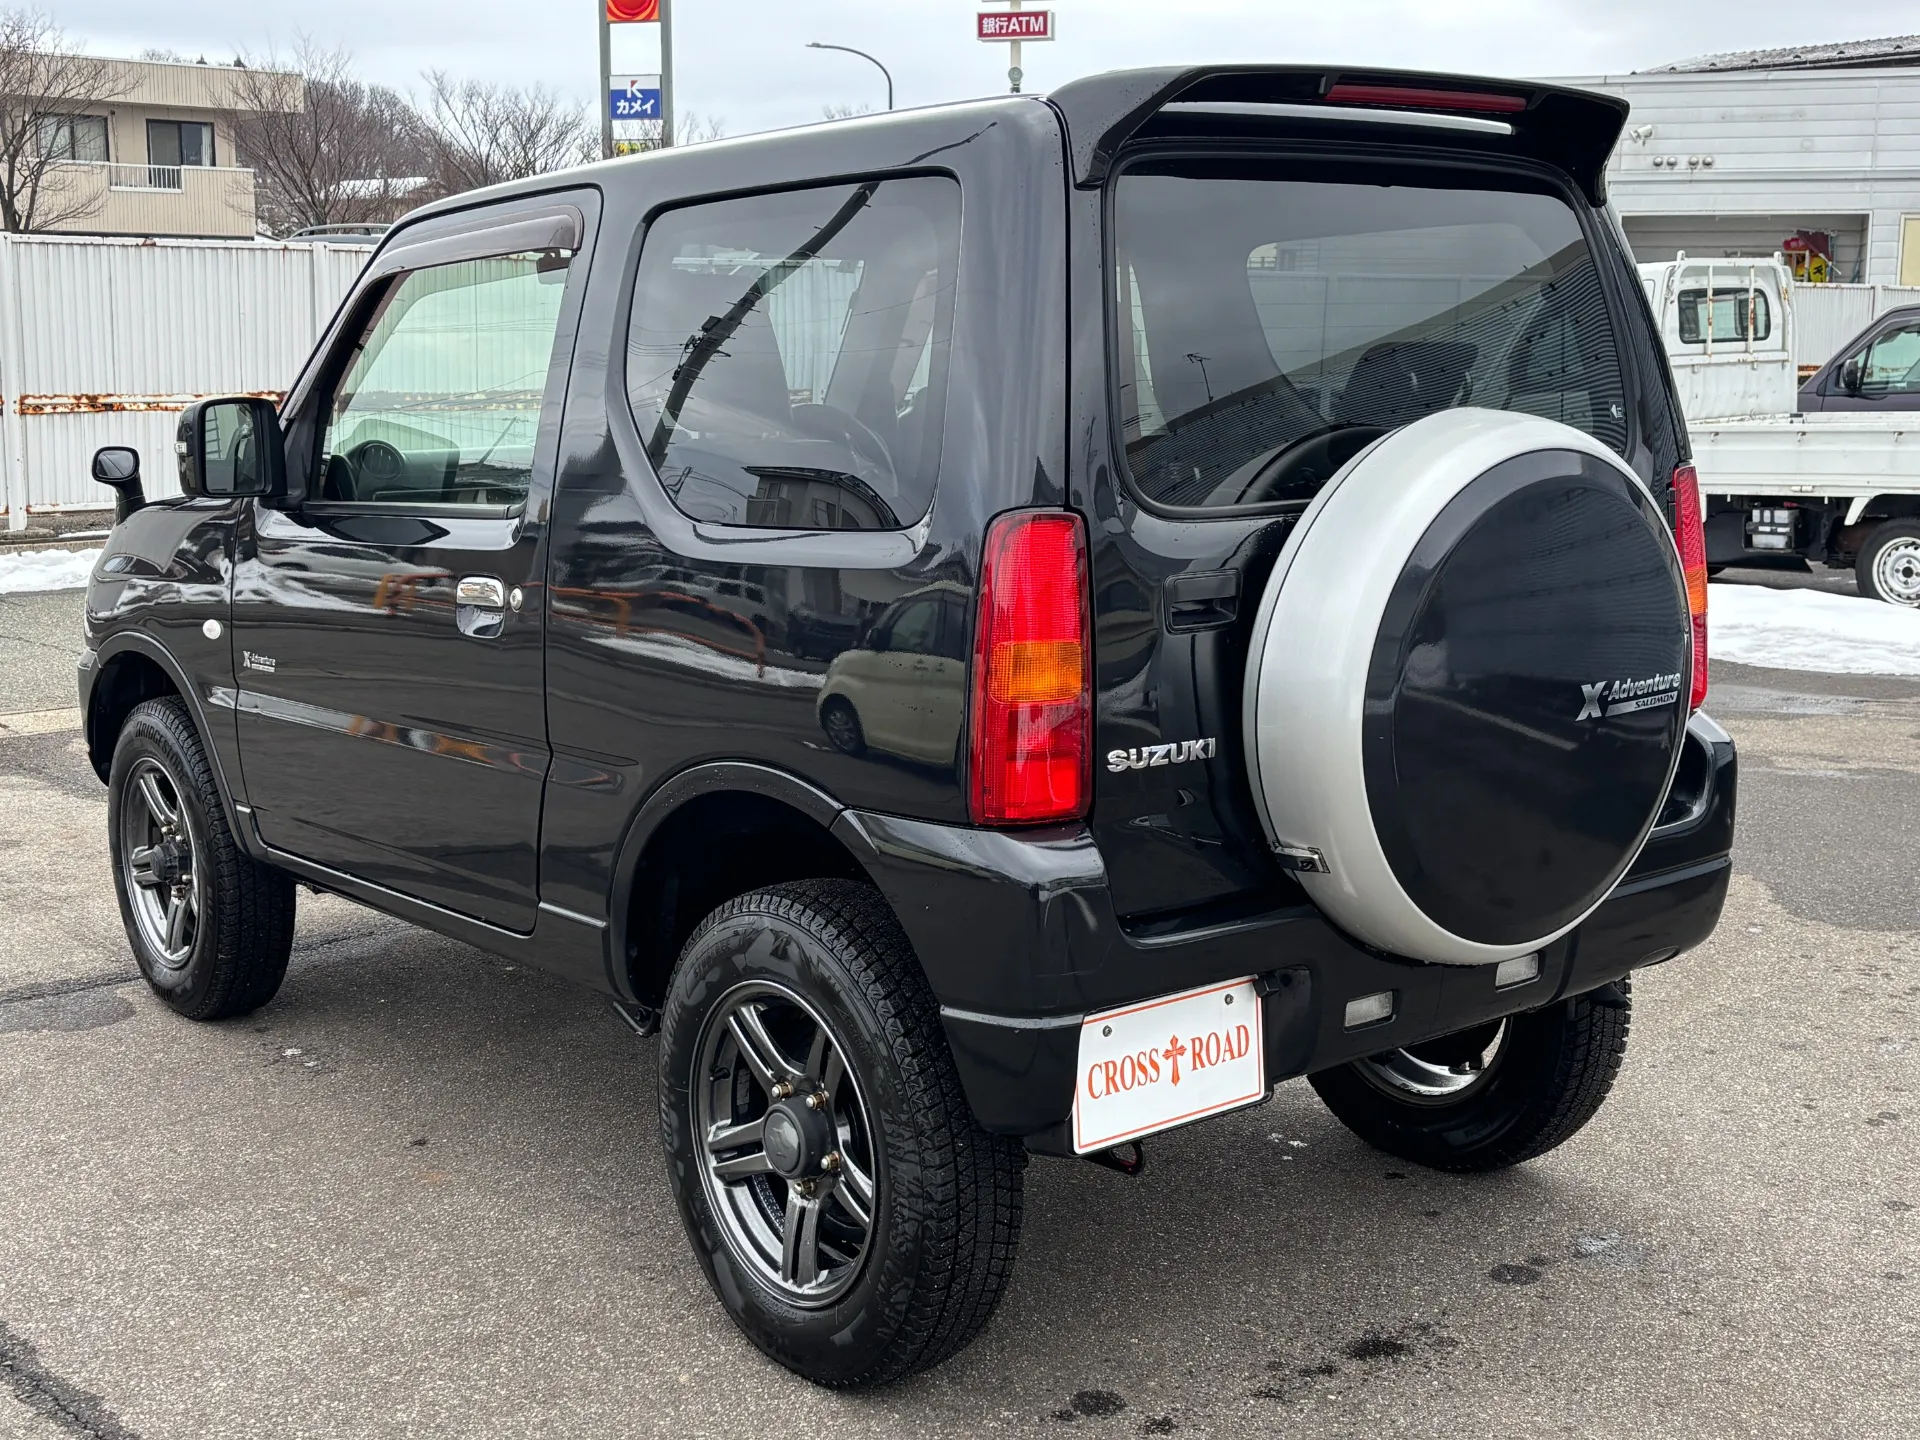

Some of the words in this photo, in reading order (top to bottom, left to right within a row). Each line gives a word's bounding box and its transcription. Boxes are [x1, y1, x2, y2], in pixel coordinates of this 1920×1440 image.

[982, 16, 1044, 34] 銀行ATM
[616, 99, 655, 115] カメイ
[1575, 672, 1681, 721] X-Adventure
[1634, 694, 1675, 709] SALOMON
[1107, 738, 1215, 772] SUZUKI
[1087, 1048, 1161, 1100] CROSS
[1190, 1024, 1250, 1071] ROAD
